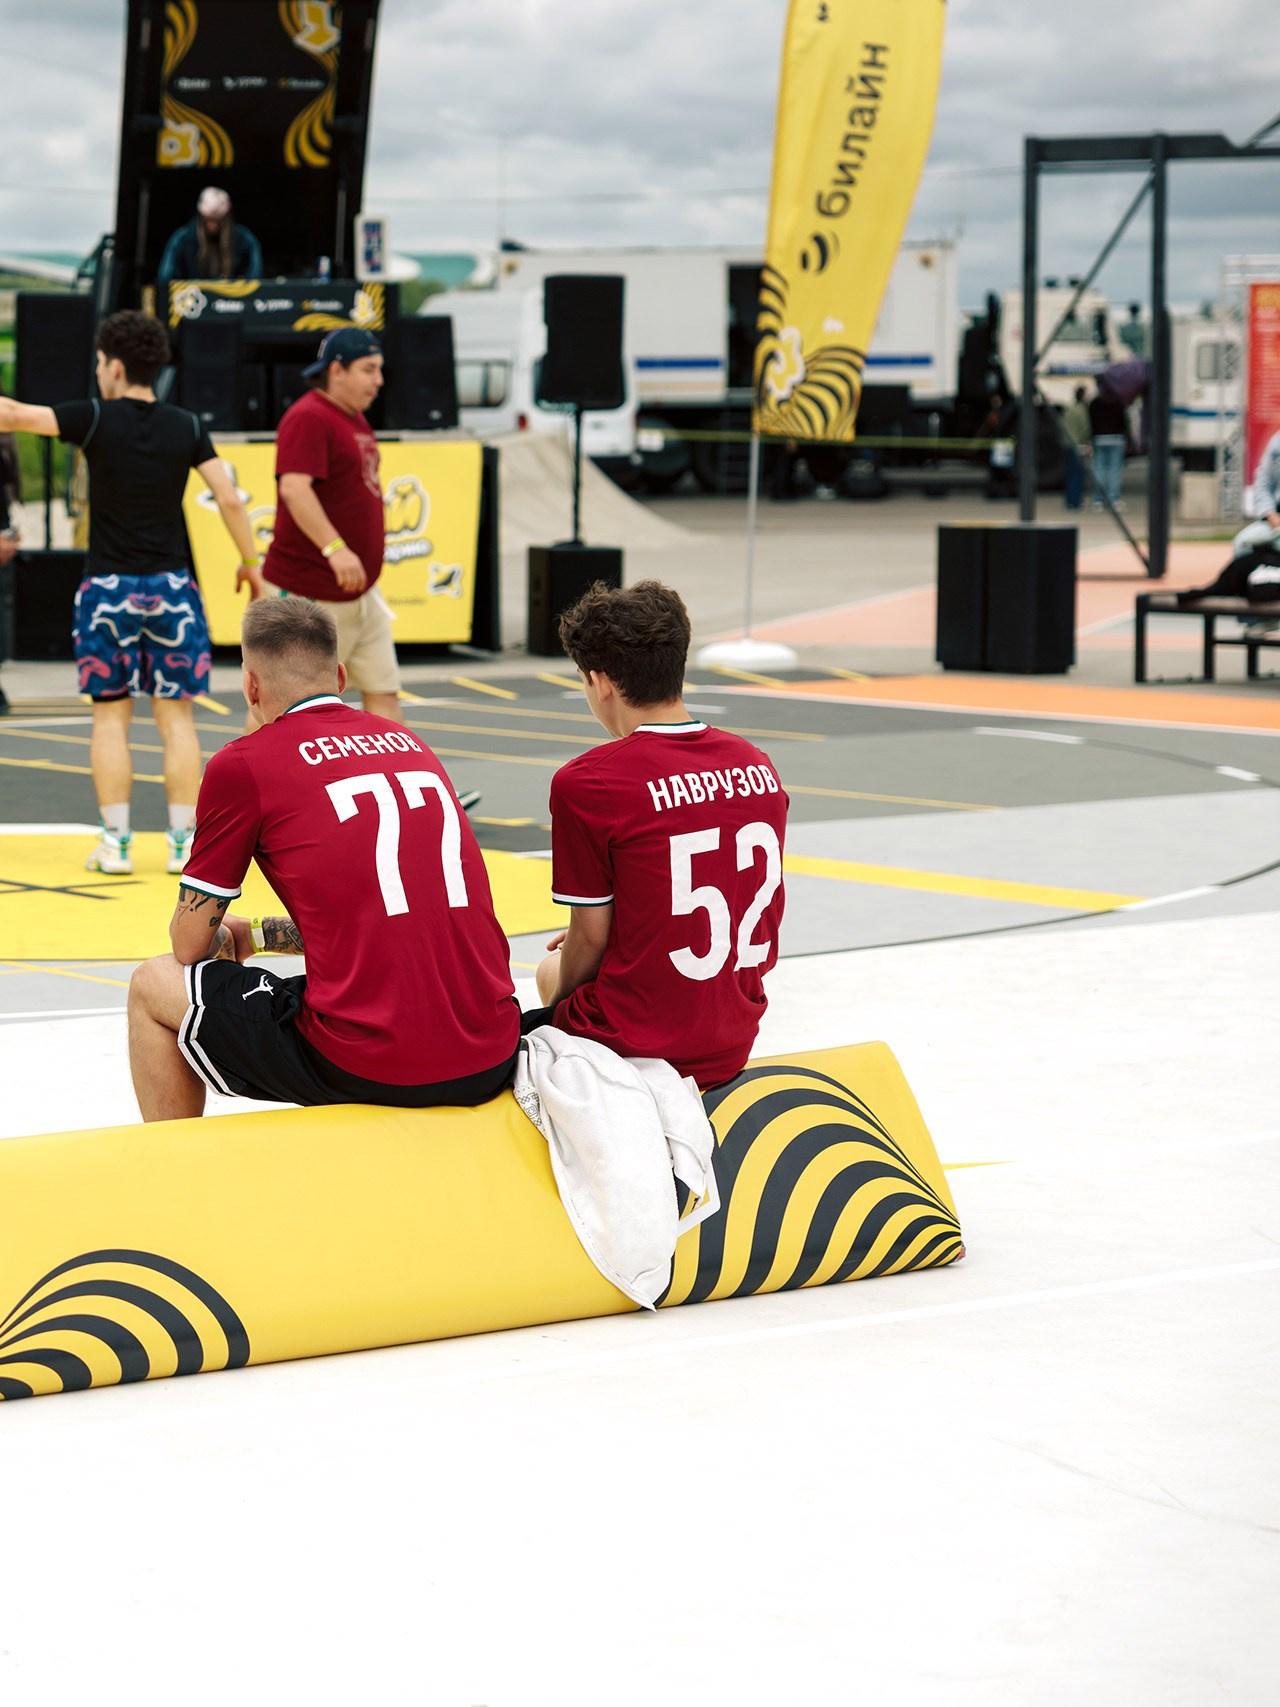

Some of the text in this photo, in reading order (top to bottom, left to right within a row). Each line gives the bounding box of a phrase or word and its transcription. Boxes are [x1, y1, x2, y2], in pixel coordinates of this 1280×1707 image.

[816, 42, 891, 219] билайн
[298, 731, 423, 766] СЕМЕНОВ
[646, 765, 779, 812] НАВРУЗОВ
[324, 770, 469, 917] 77
[668, 821, 782, 981] 52
